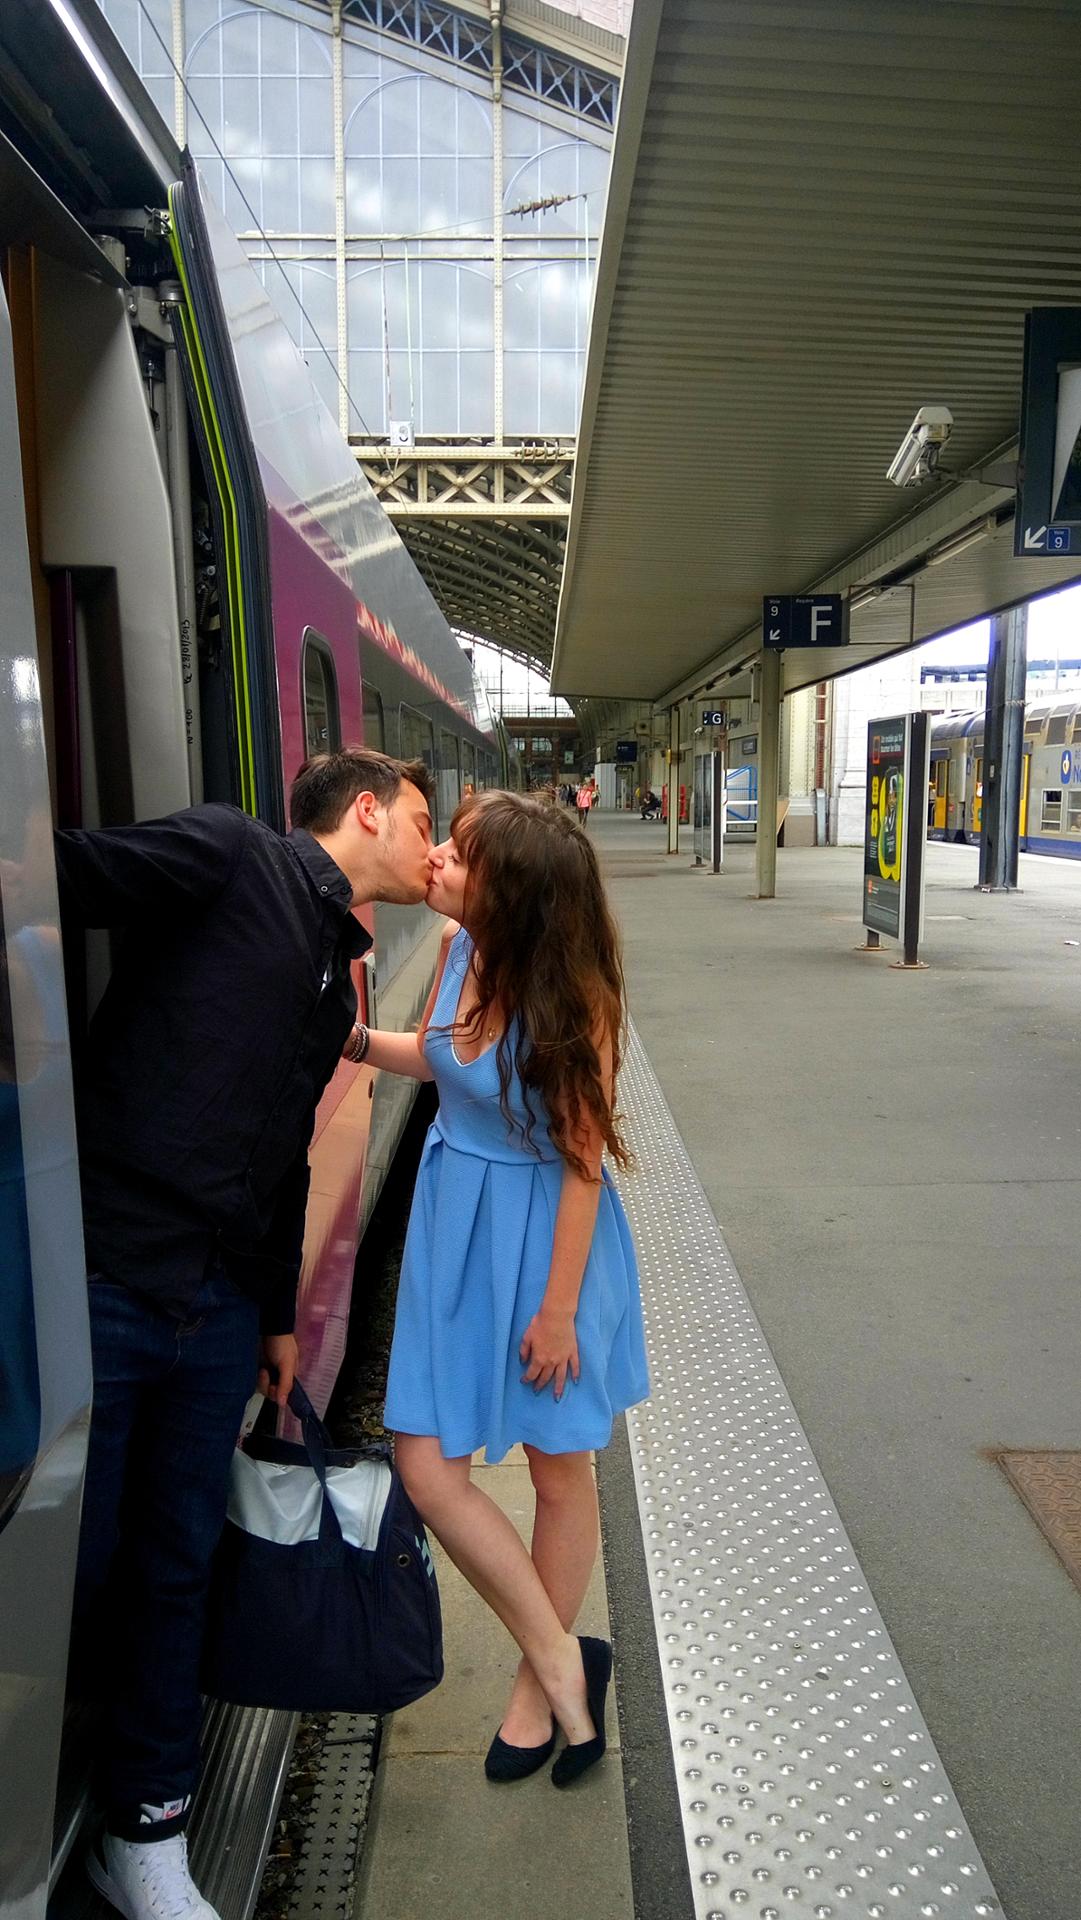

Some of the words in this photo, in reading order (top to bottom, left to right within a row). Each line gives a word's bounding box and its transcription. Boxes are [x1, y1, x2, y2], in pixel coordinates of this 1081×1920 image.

[1054, 537, 1063, 548] 9
[771, 606, 778, 616] 9
[811, 606, 832, 641] F
[712, 713, 722, 724] G
